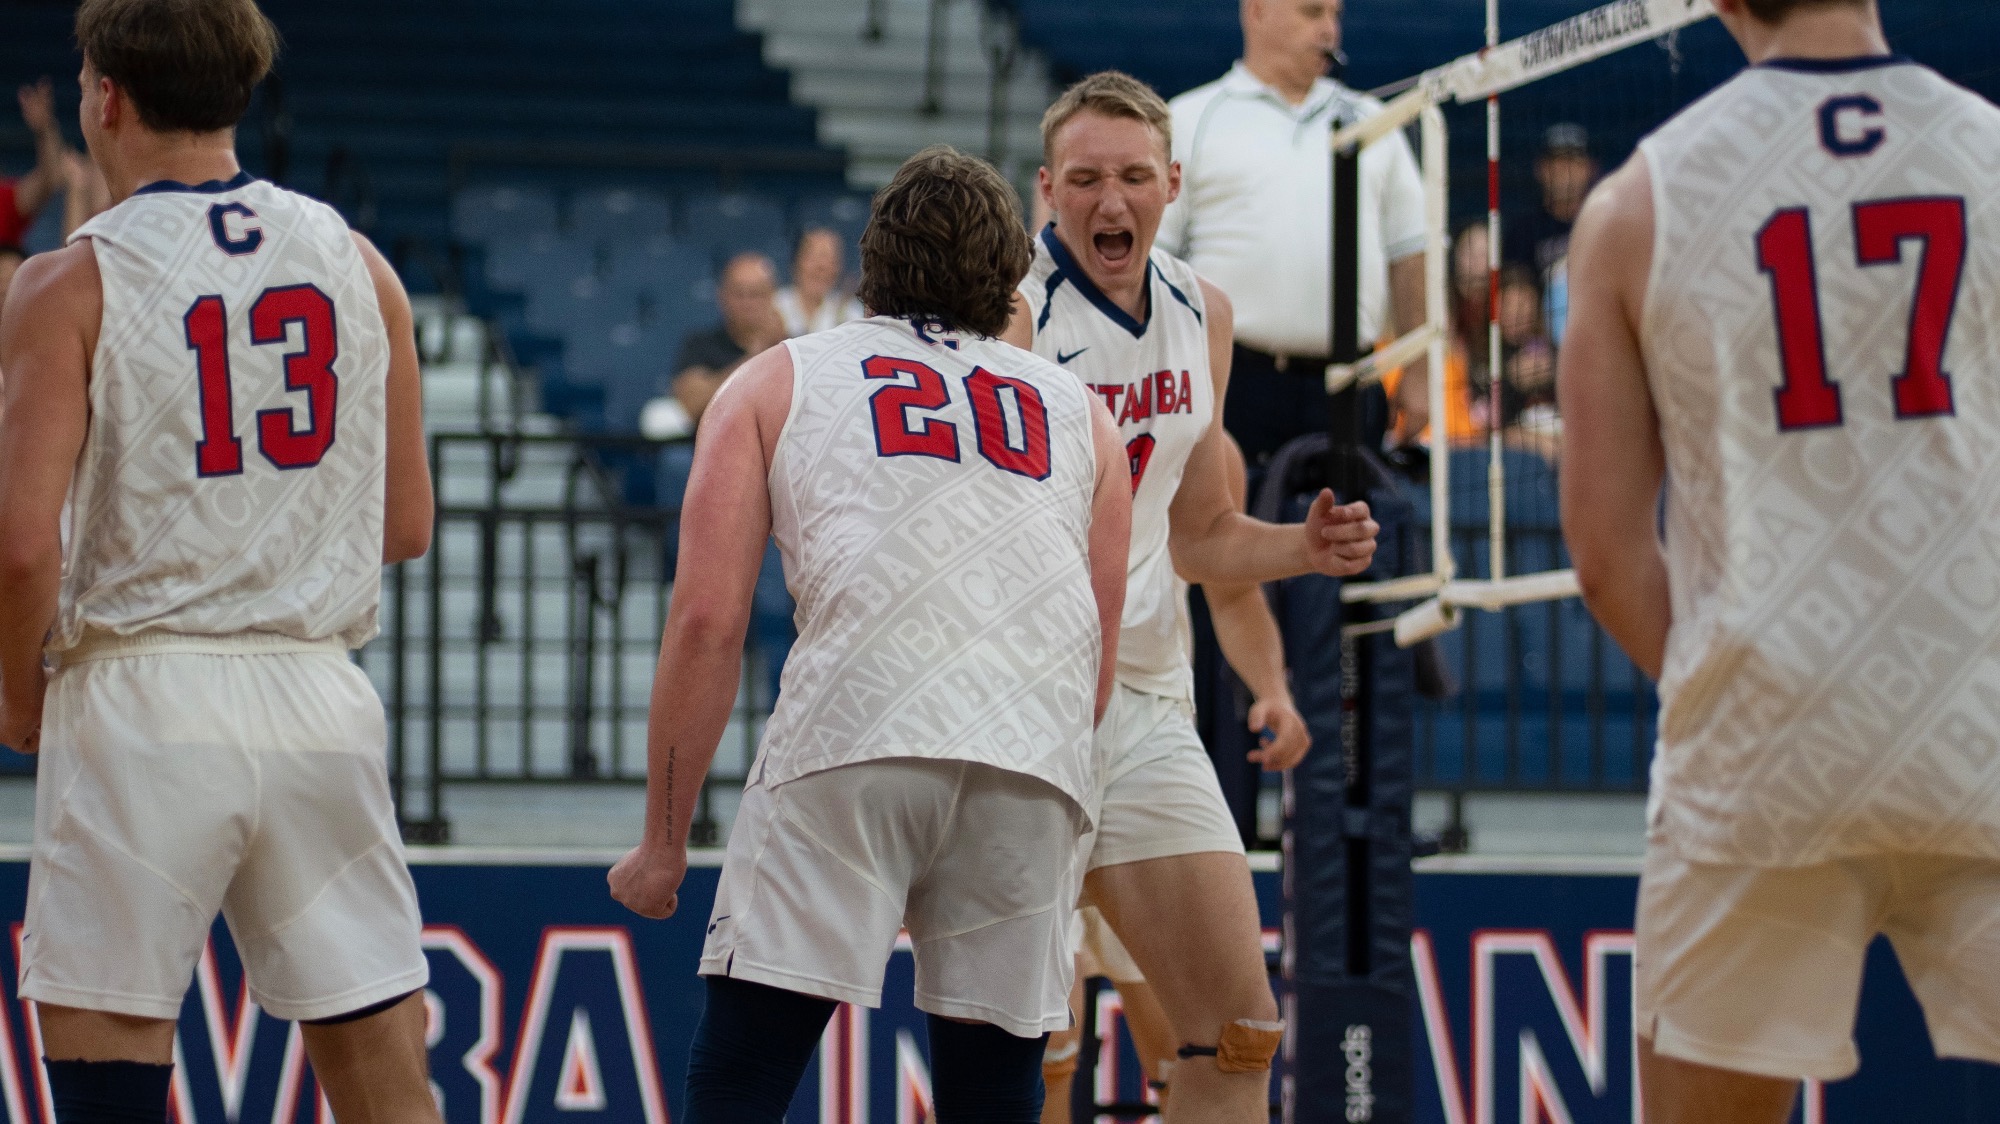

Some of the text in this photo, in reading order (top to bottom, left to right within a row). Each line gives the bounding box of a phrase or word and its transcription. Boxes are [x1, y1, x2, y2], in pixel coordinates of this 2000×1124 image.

[1816, 92, 1887, 160] C
[206, 202, 265, 258] C
[1754, 195, 1967, 432] 17
[183, 282, 338, 478] 13
[861, 354, 1051, 482] 20
[794, 601, 967, 778] CATAWBA
[1340, 1024, 1376, 1123] sports
